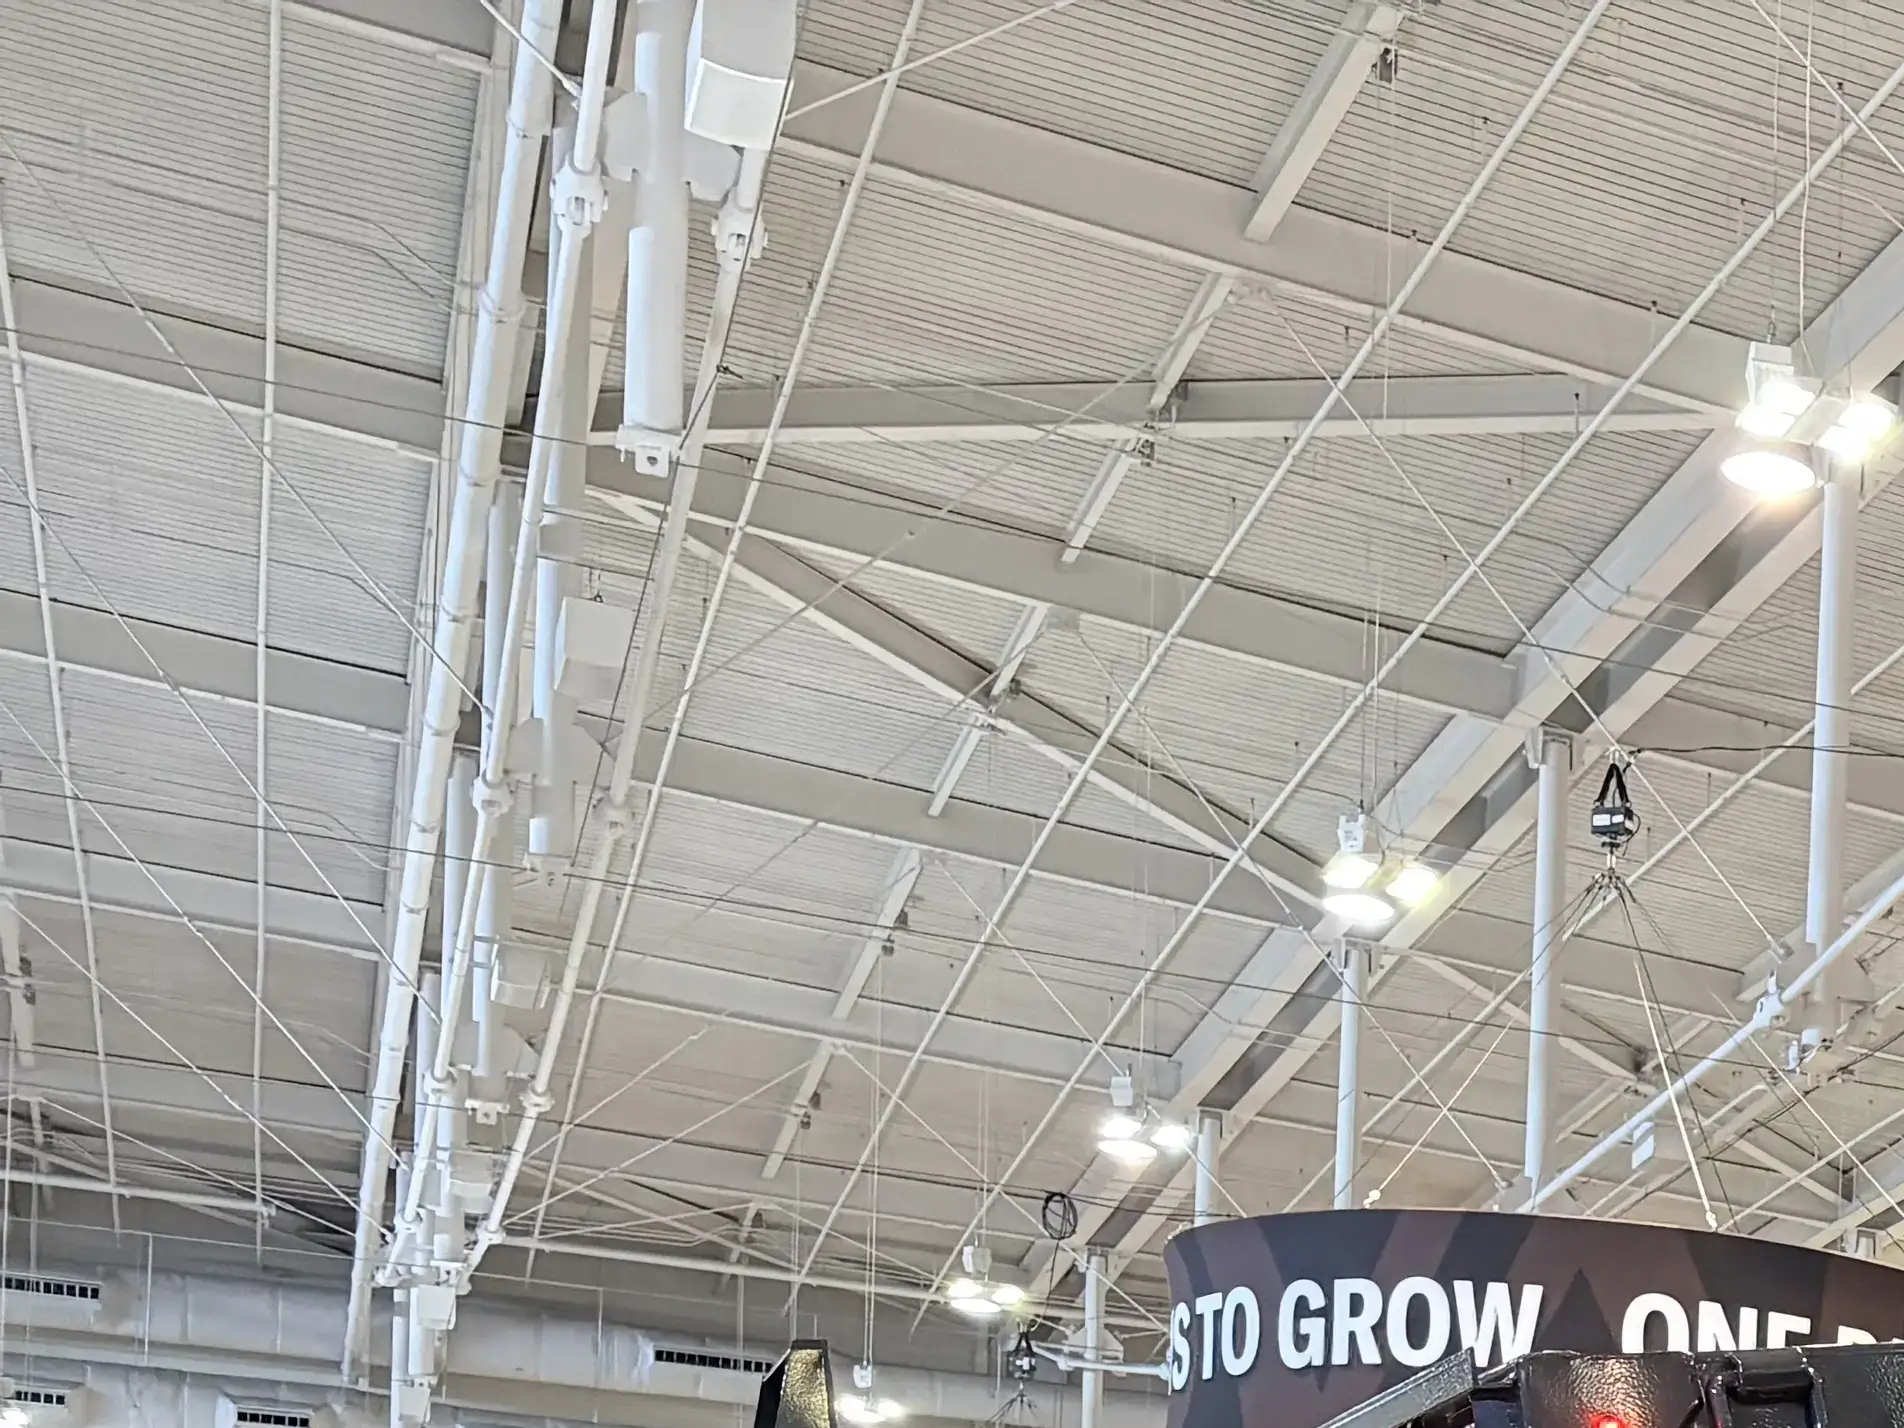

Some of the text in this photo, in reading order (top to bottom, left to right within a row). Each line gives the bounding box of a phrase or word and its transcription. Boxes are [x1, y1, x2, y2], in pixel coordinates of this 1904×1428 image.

[1169, 1276, 1544, 1394] S TO GROW
